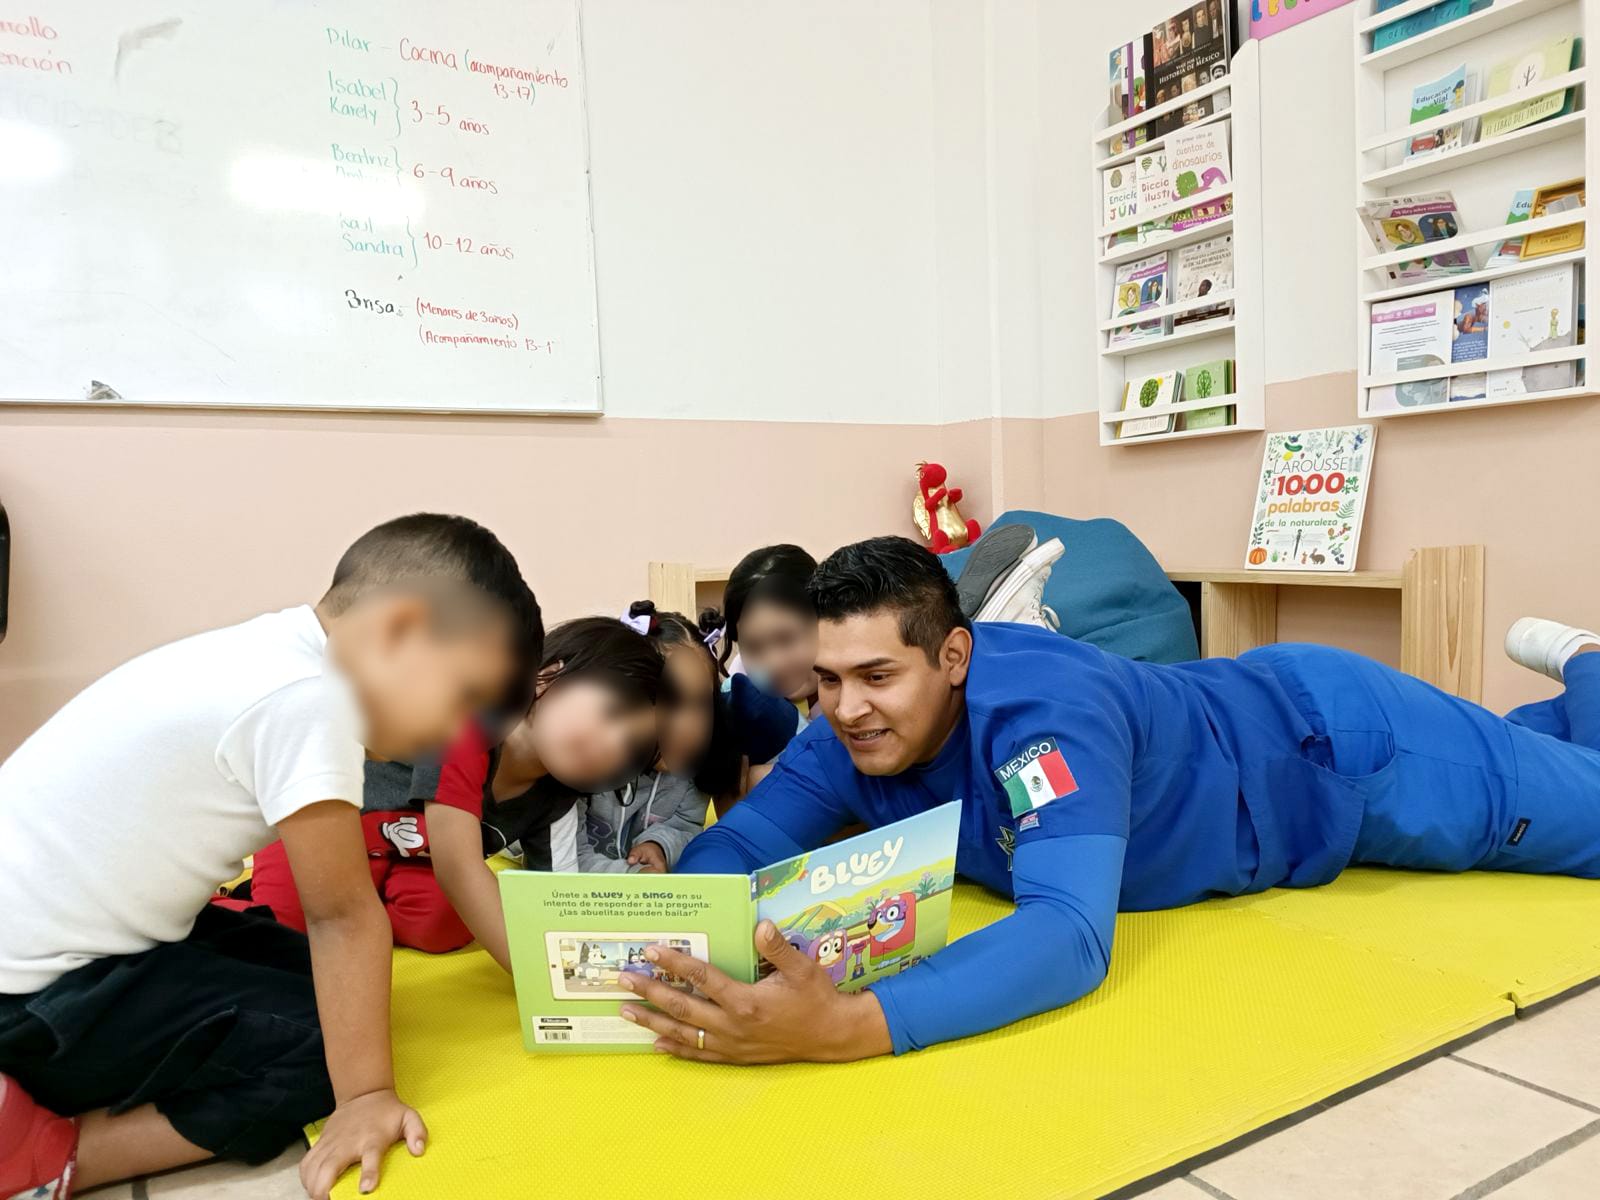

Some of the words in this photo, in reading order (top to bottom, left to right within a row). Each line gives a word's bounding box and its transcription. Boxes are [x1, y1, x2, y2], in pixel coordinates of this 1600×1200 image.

[399, 37, 457, 71] Cocina
[328, 70, 388, 101] Isabel
[1172, 151, 1223, 170] dinosaurios
[342, 233, 404, 258] Sandra
[1273, 457, 1348, 475] LAROUSSE
[1277, 472, 1345, 496] 1000
[1267, 498, 1340, 517] palabras
[1264, 519, 1275, 527] de
[1278, 518, 1287, 527] la
[1290, 518, 1338, 527] naturaleza
[1000, 742, 1051, 780] MEXICO
[810, 836, 904, 895] BLUEY
[551, 890, 580, 899] Únete
[543, 900, 577, 908] intento
[579, 900, 591, 908] de
[594, 901, 643, 909] responder
[655, 901, 663, 909] la
[666, 901, 712, 910] pregunta:
[559, 909, 578, 917] ¿las
[581, 909, 625, 917] abuelitas
[627, 909, 663, 918] pueden
[665, 909, 699, 917] bailar?
